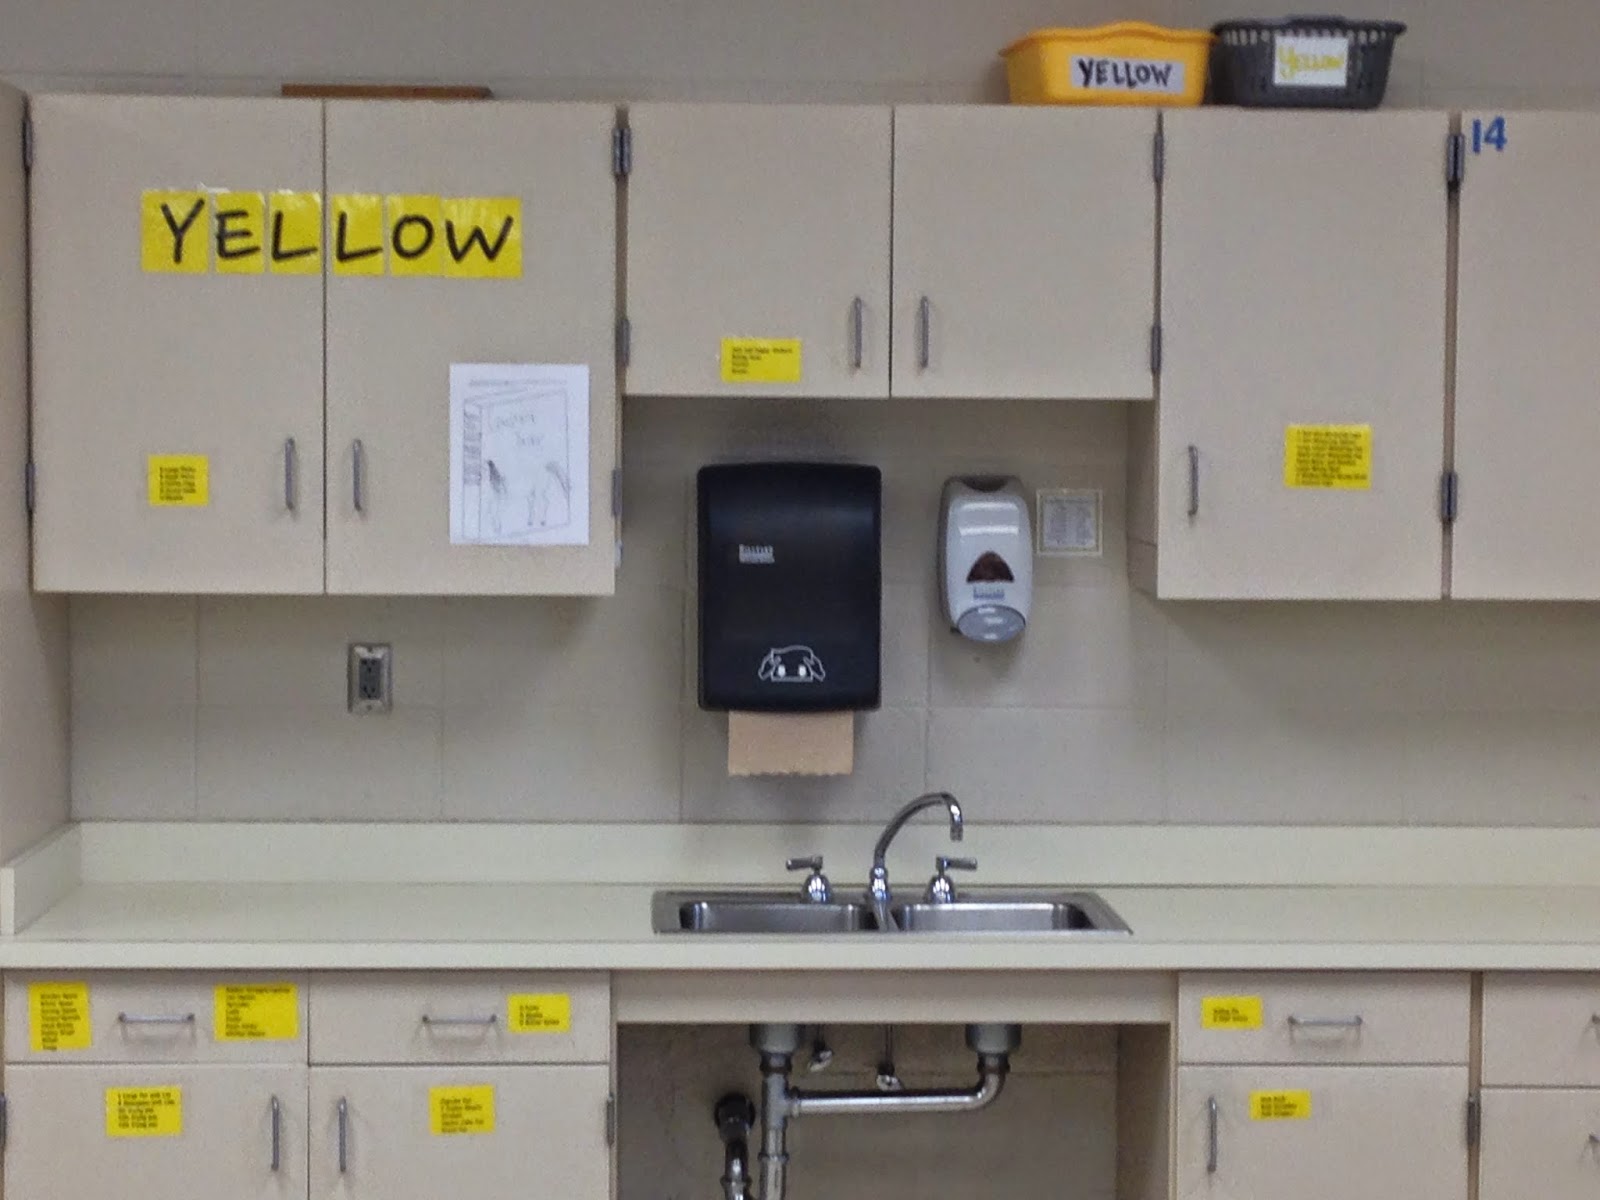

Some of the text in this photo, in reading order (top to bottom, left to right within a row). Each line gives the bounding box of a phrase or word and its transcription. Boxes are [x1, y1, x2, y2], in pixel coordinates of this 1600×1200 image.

[1078, 58, 1172, 89] YELLOW
[1472, 116, 1507, 153] 14
[161, 199, 514, 264] YELLOW
